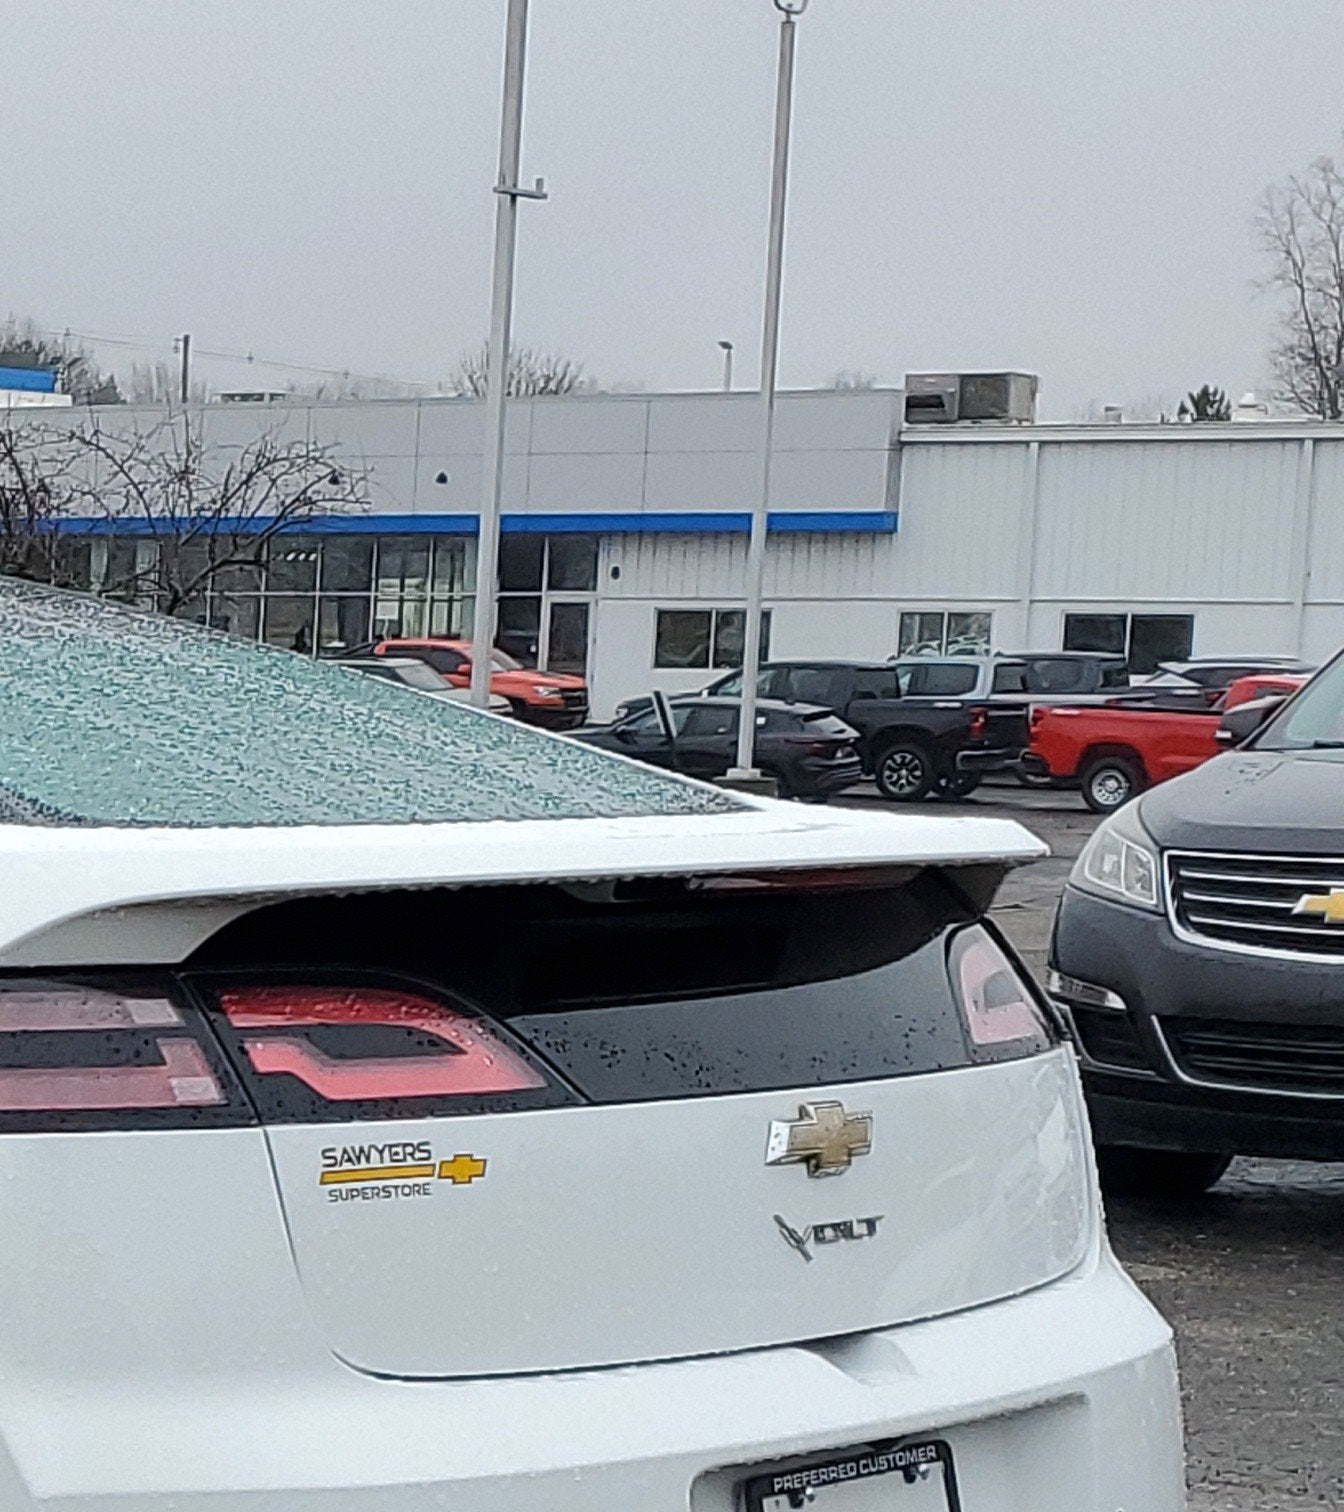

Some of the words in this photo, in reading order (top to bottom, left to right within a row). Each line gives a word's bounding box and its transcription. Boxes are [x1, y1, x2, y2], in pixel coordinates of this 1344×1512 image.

[321, 1141, 432, 1168] SAWYERS
[328, 1182, 432, 1203] SUPERSTORE
[772, 1214, 885, 1263] VOLT
[772, 1461, 857, 1493] PREFERRED
[858, 1445, 938, 1475] CUSTOMER
